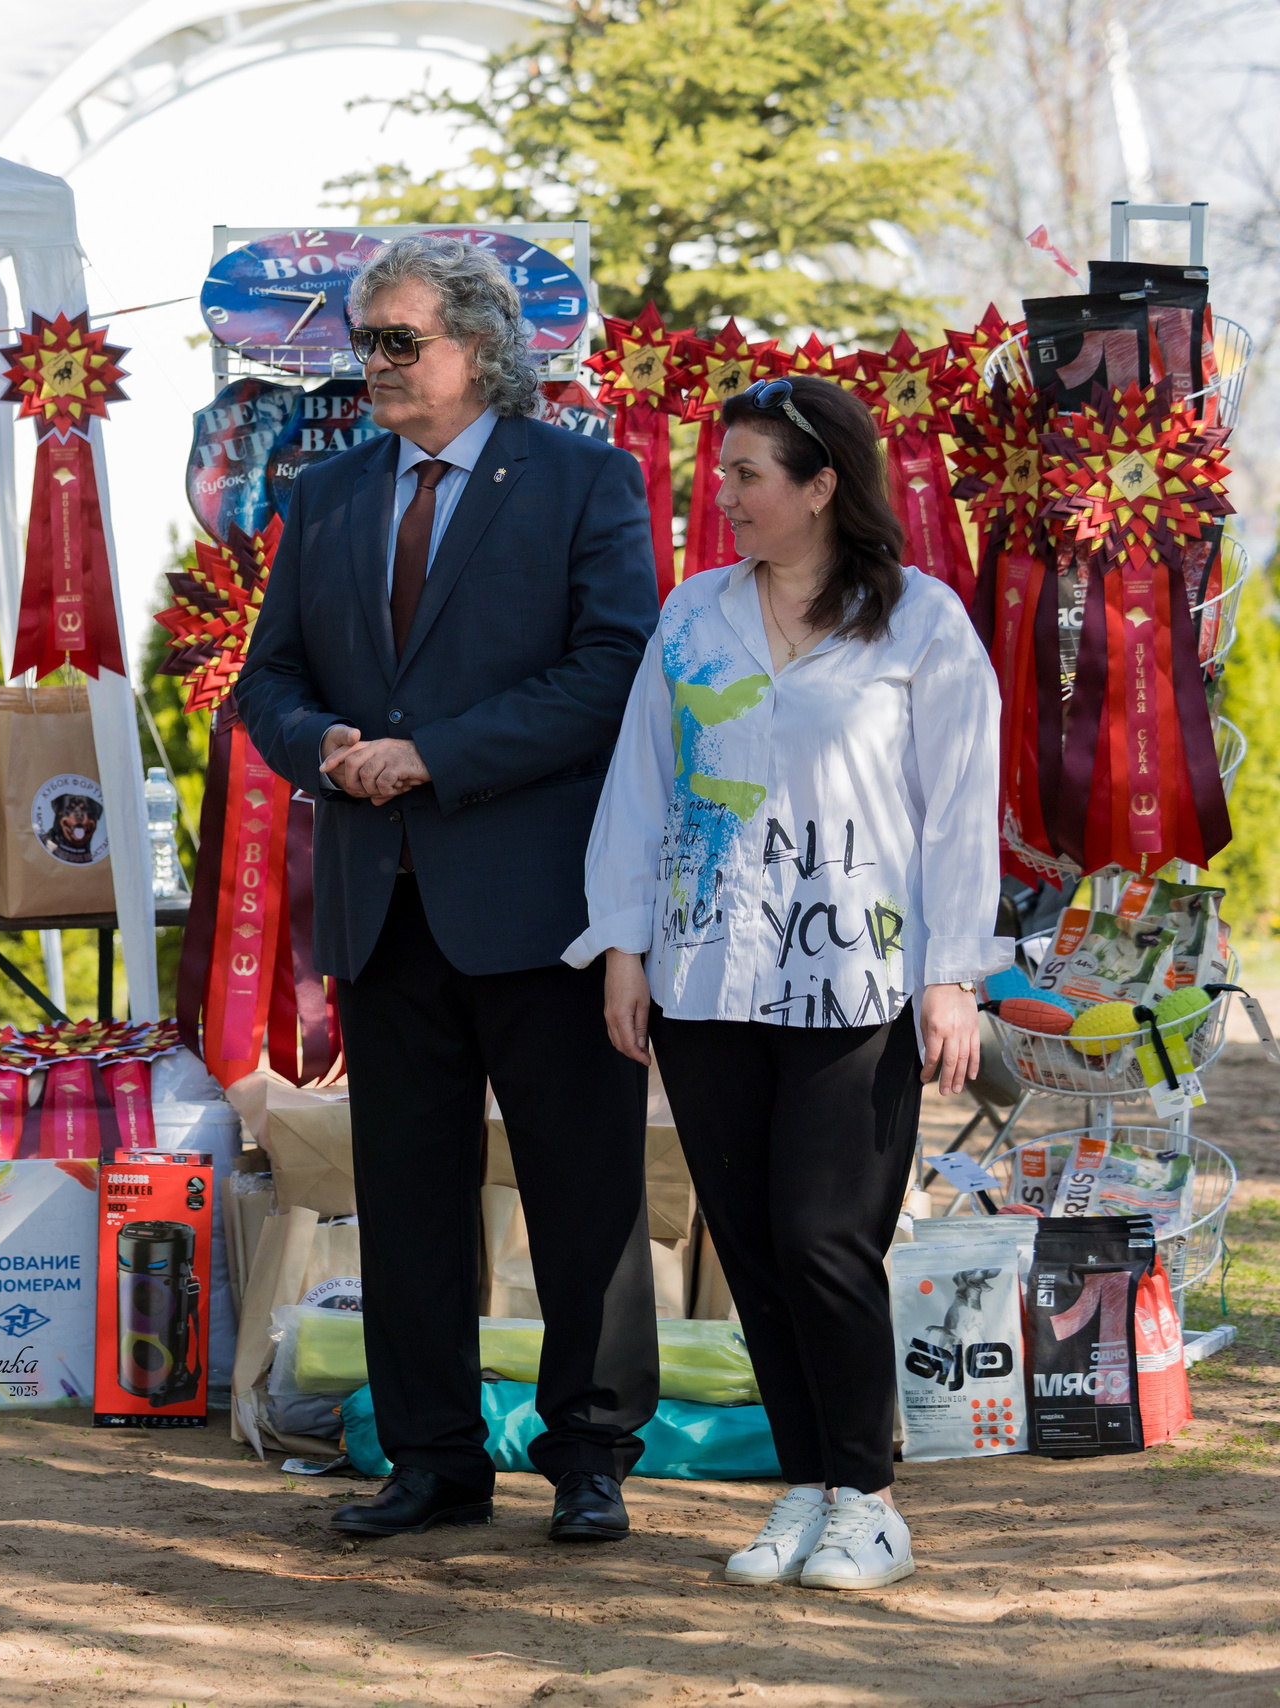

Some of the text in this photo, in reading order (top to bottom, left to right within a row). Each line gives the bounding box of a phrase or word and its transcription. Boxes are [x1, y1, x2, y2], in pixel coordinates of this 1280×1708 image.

[299, 279, 347, 291] Форт
[302, 396, 372, 419] BES
[540, 402, 607, 437] EST
[198, 430, 275, 468] PUP
[195, 474, 246, 495] Кубок
[1135, 643, 1148, 774] ЛУЧШАЯ СУКА
[41, 778, 104, 801] КУБОК ФОРТУ
[762, 818, 877, 880] ALL
[240, 842, 262, 913] BOS
[761, 900, 906, 969] YOUR
[107, 1184, 153, 1196] SPEAKER
[306, 1279, 342, 1303] КУБОК
[1090, 1348, 1128, 1363] ОДНО
[1033, 1370, 1131, 1398] МЯСО
